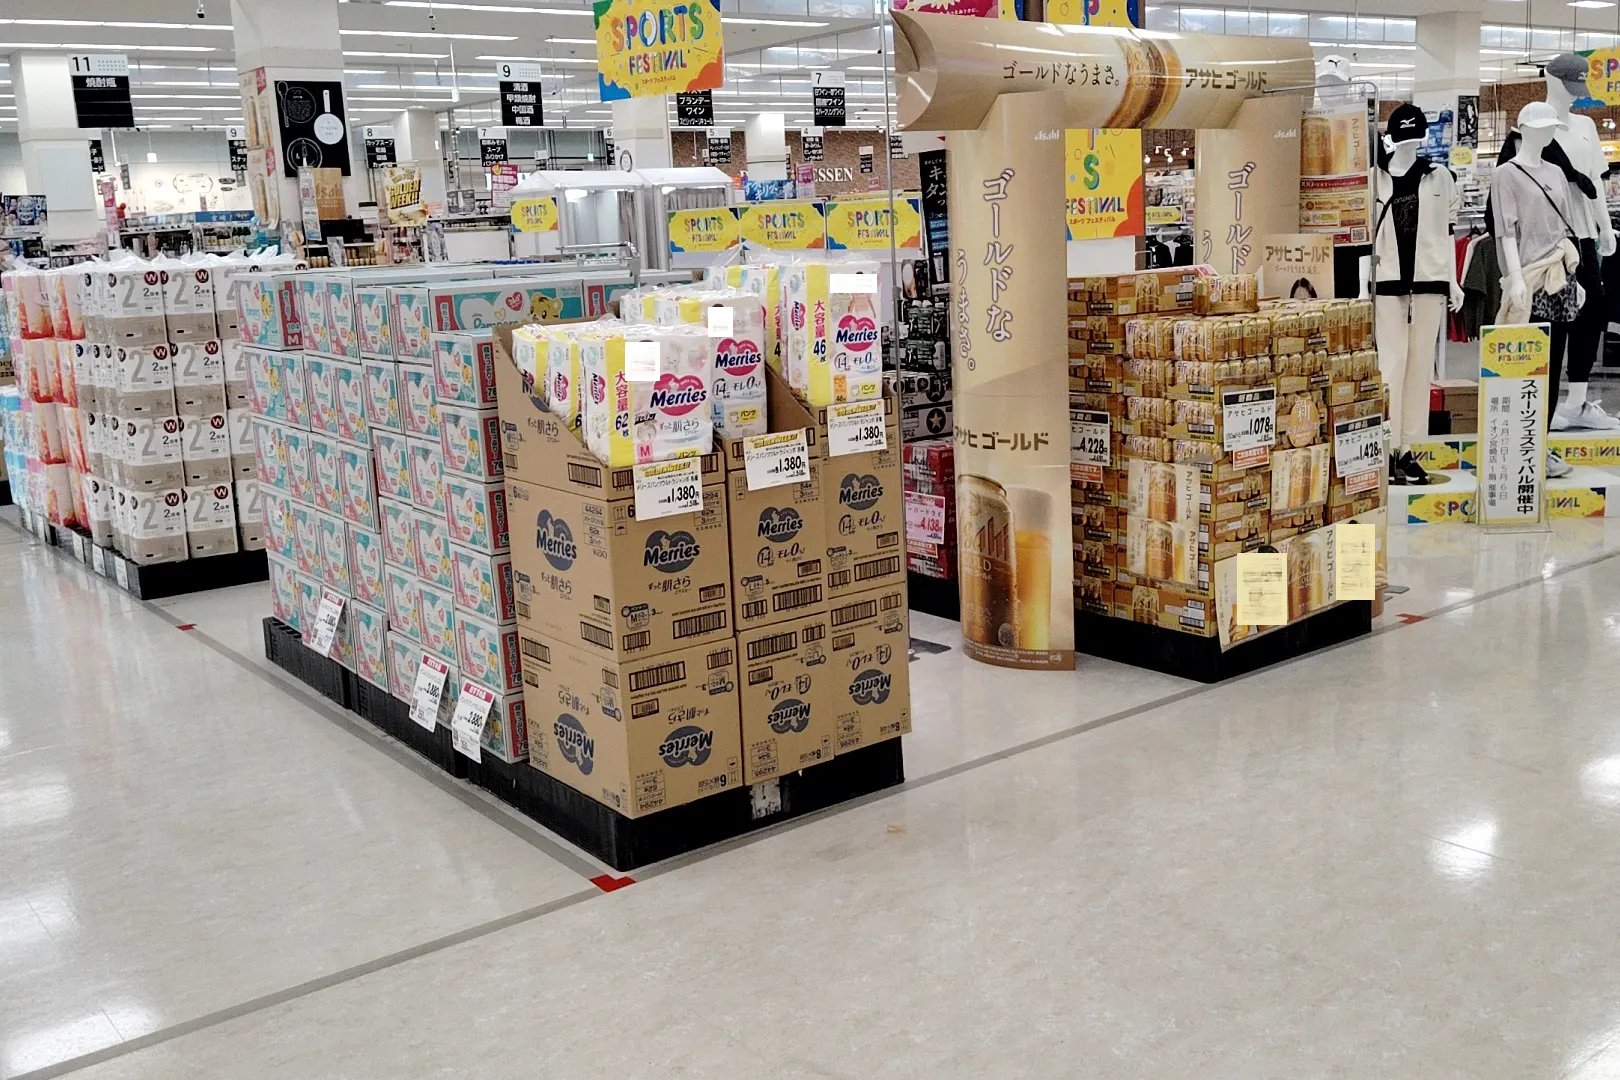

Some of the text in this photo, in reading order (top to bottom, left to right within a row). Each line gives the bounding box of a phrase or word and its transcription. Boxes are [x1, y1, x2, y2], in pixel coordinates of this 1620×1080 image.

[611, 2, 704, 52] SPORTS
[72, 56, 90, 72] 11
[629, 49, 687, 75] FESTIVAL
[502, 64, 510, 78] 9
[816, 72, 822, 84] 7
[1003, 60, 1120, 87] ゴールドなうまさ。
[678, 96, 710, 104] ブランデー
[686, 107, 705, 115] ワイン
[230, 128, 237, 138] 9
[367, 128, 373, 137] 8
[482, 128, 486, 137] 7
[606, 128, 612, 136] 6
[710, 128, 714, 136] 5
[1034, 131, 1060, 142] Asahi
[1274, 128, 1297, 139] Asahi
[390, 179, 421, 197] GOLDEN
[684, 216, 724, 232] SPORTS
[758, 209, 805, 228] SPORTS
[847, 208, 899, 228] SPORTS
[1226, 161, 1256, 276] ゴールド
[982, 168, 1015, 342] ゴールドな
[1266, 245, 1330, 263] アサヒゴールド
[146, 274, 157, 283] W
[198, 271, 208, 280] W
[956, 249, 976, 370] うまさ。
[814, 300, 826, 338] 大容量
[287, 335, 299, 346] M
[836, 327, 878, 344] Merries
[156, 348, 166, 357] W
[206, 344, 217, 352] W
[1488, 340, 1542, 355] SPORTS
[715, 350, 762, 369] Merries
[614, 370, 629, 412] 大容量
[715, 382, 727, 394] 14
[650, 386, 707, 408] Merries
[740, 409, 756, 418] パンツ
[1227, 406, 1272, 418] アサヒゴールド
[165, 422, 176, 430] W
[212, 418, 222, 427] W
[527, 416, 560, 436] ずっと肌さら
[659, 420, 700, 434] ずっと肌さら
[1072, 426, 1106, 435] ヒゴールド
[1250, 416, 1274, 436] 1,078円
[859, 426, 884, 440] 1,380円
[1338, 431, 1380, 446] アサヒゴールド
[640, 446, 650, 458] M
[1080, 436, 1108, 456] 4,228円
[1359, 441, 1382, 461] 1,428円
[1516, 380, 1539, 514] スポーツフェスティバル開催中
[779, 456, 806, 472] 1,380円
[166, 494, 177, 504] W
[216, 488, 226, 497] W
[672, 484, 700, 502] 1,380円
[838, 484, 884, 504] Merries
[627, 504, 636, 518] 6
[758, 517, 804, 537] Merries
[536, 531, 577, 560] Merries
[643, 544, 700, 568] Merries
[1326, 529, 1334, 601] アサヒゴールド
[540, 571, 572, 594] ずっと肌さら
[648, 576, 692, 592] ずっと肌さら
[848, 674, 892, 695] Merries
[767, 702, 811, 724] Merries
[894, 720, 900, 732] 8
[553, 722, 594, 759] Merries
[658, 730, 714, 756] Merries
[816, 748, 822, 760] 8
[720, 774, 726, 786] 6
